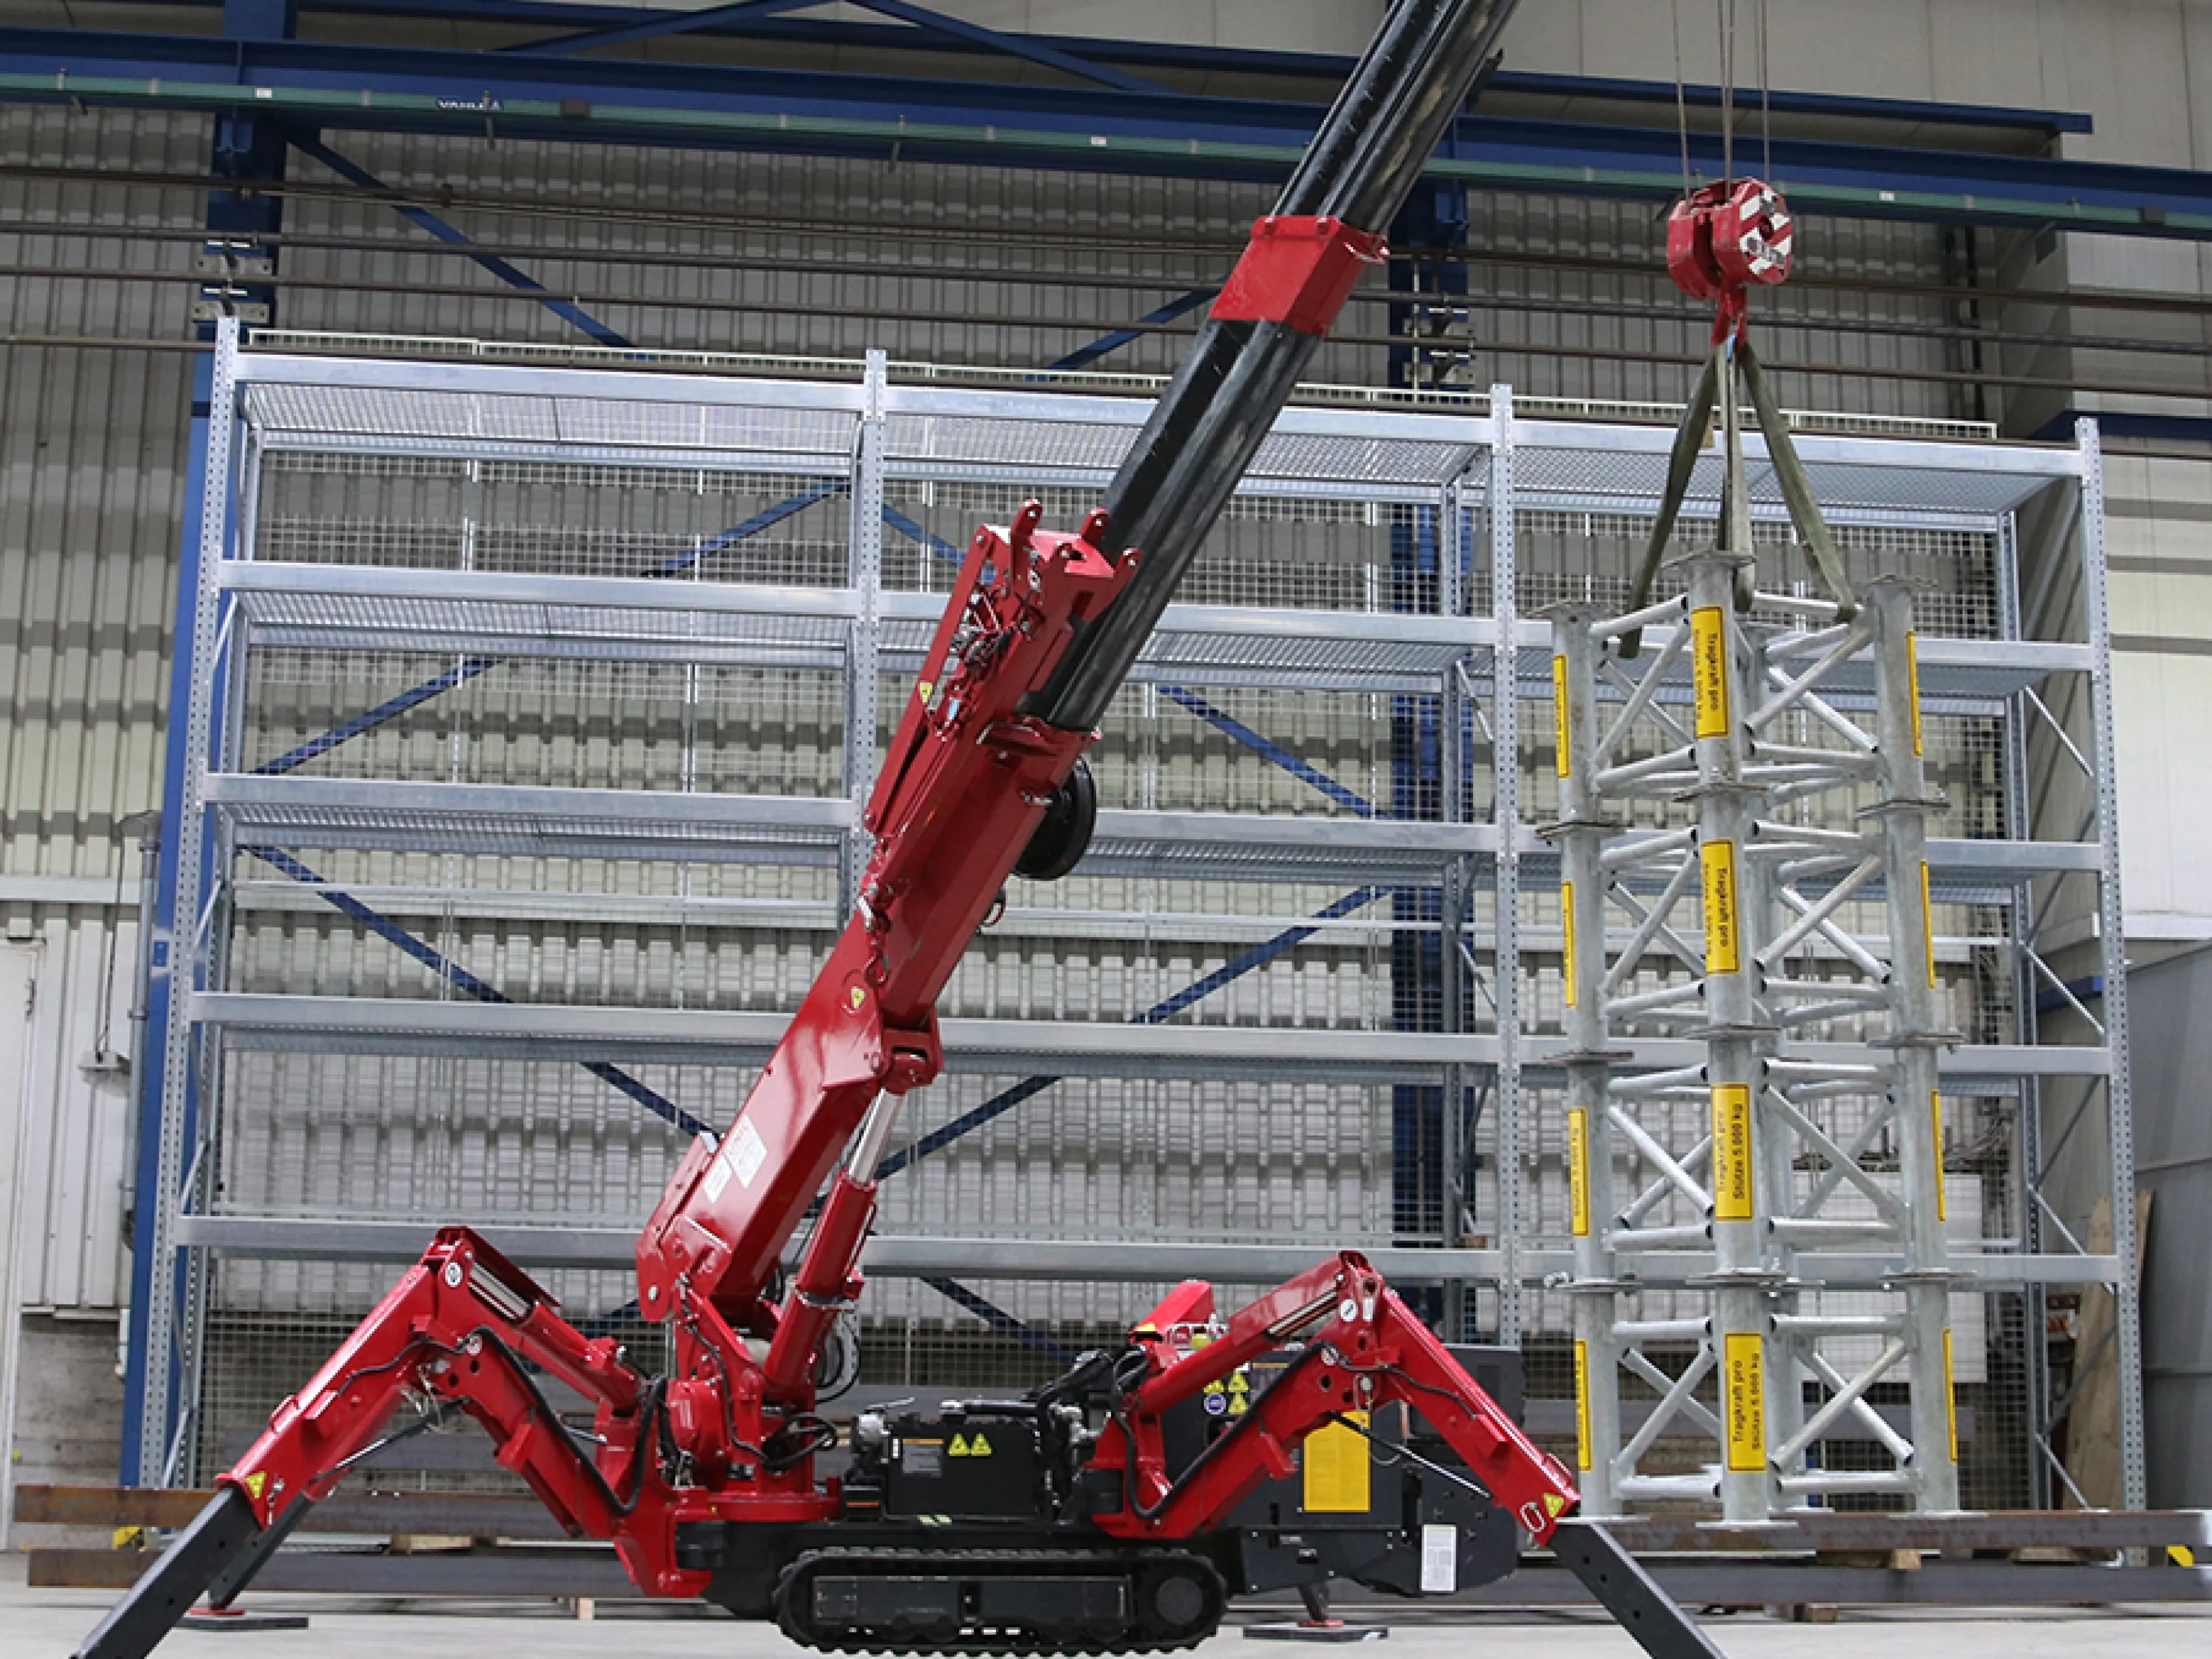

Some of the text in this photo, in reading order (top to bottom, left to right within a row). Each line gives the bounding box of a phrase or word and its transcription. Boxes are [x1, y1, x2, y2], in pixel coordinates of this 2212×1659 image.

[1706, 633, 1719, 711] Tragkraft pro
[1715, 868, 1729, 947] Tragkraft pro
[1717, 1111, 1728, 1192] Tragkraft pro
[1732, 1104, 1743, 1120] kg
[1733, 1360, 1746, 1442] Tragkraft pro
